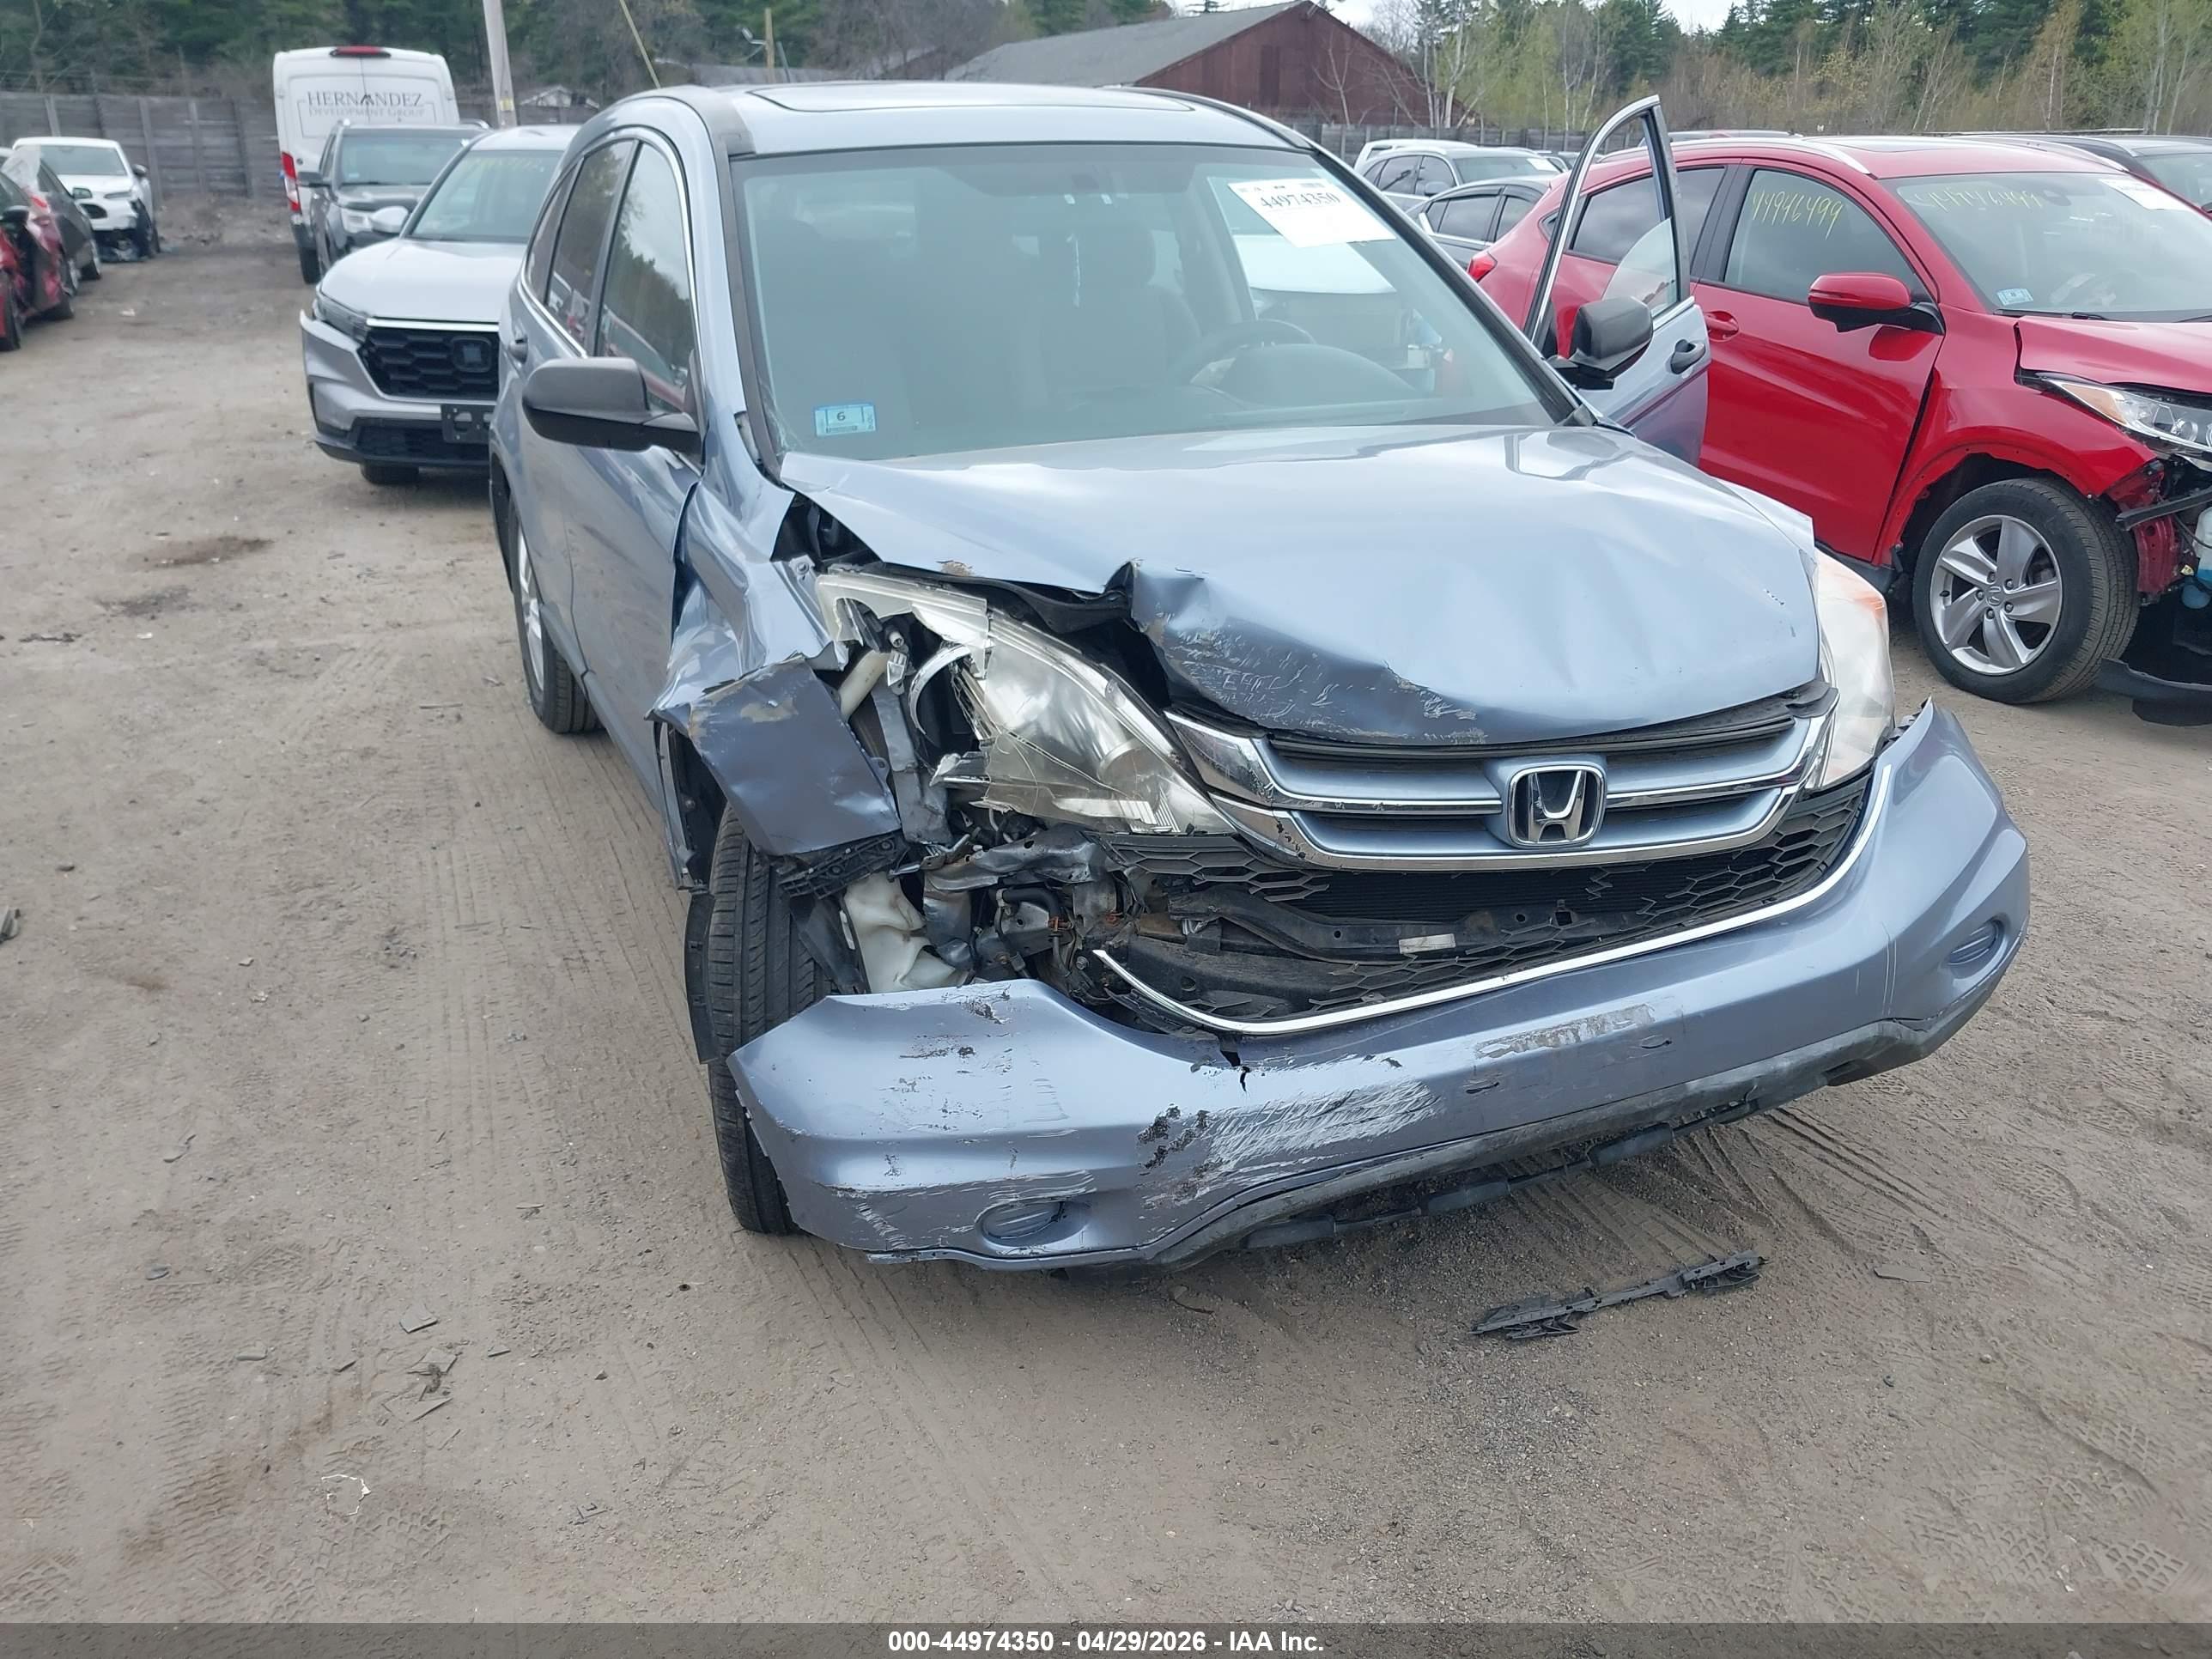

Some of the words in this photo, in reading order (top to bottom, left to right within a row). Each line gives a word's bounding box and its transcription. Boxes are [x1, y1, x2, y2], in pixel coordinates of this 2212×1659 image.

[307, 91, 424, 106] HERNANDEZ
[1260, 192, 1341, 208] 44974350
[836, 411, 846, 422] 6
